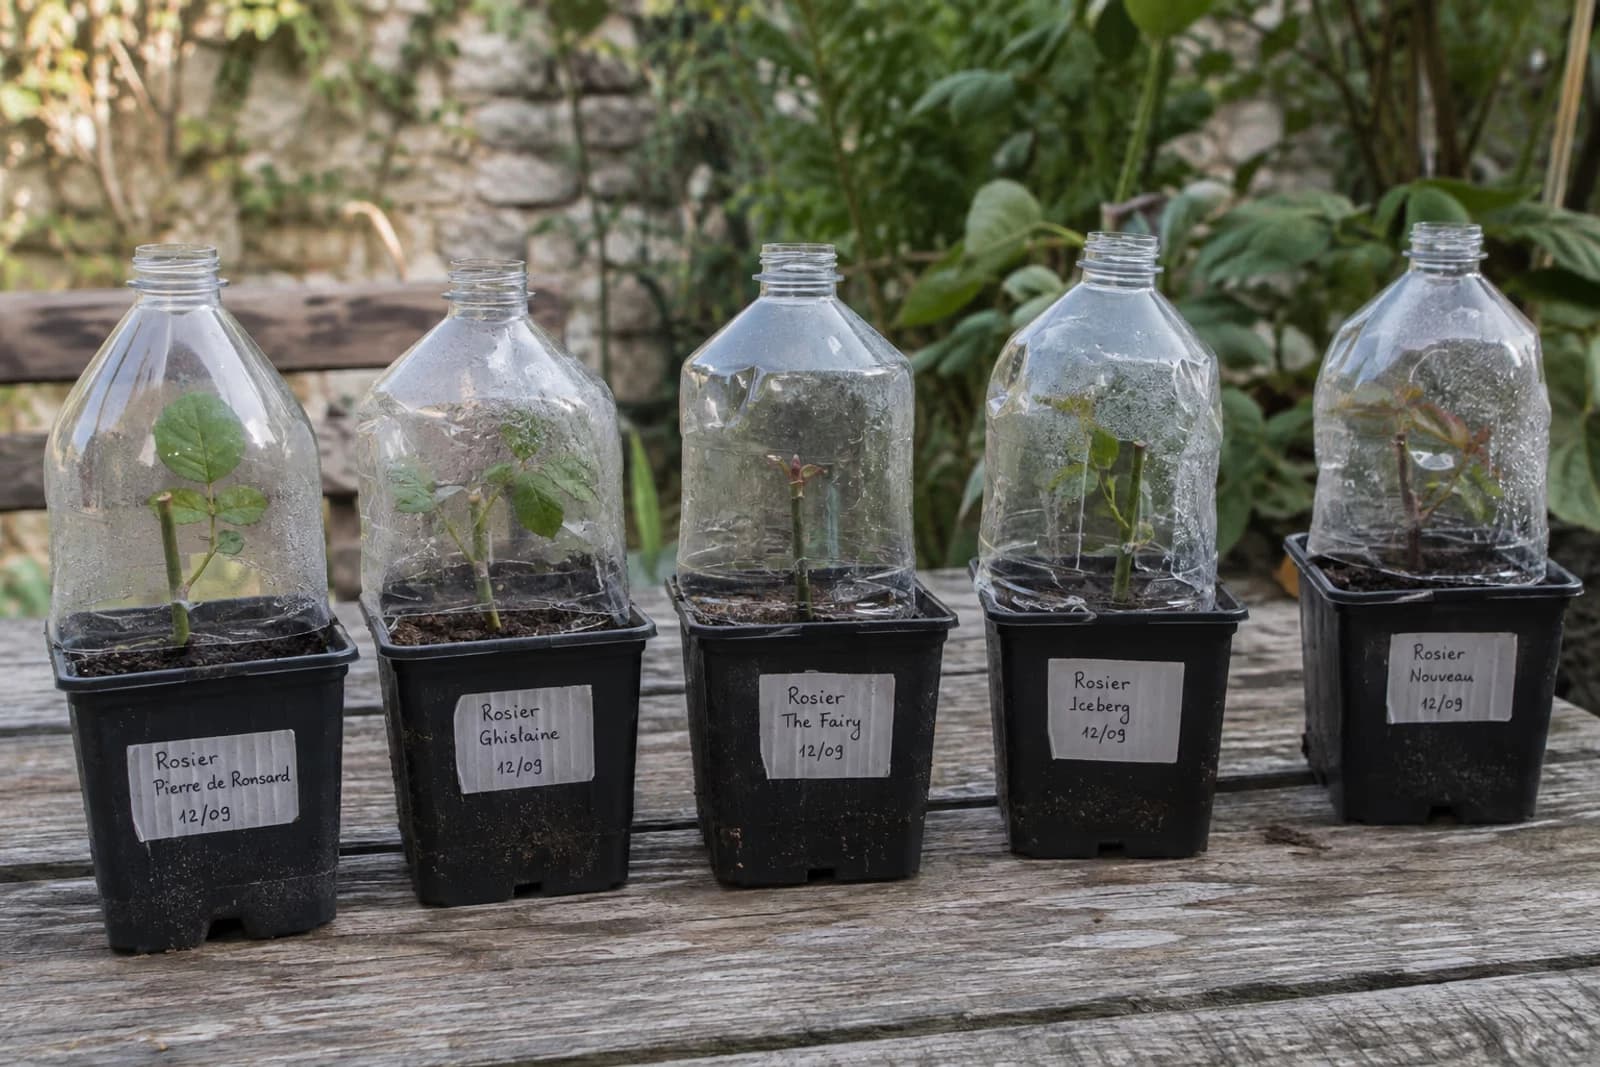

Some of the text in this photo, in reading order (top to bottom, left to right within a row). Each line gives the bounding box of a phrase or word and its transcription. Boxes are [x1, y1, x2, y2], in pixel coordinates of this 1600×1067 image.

[1413, 643, 1465, 660] Rosier
[1074, 671, 1131, 690] Rosier
[1409, 667, 1474, 683] Nouveau
[788, 686, 846, 705] Rosier
[1421, 694, 1463, 713] 12/09
[481, 703, 541, 722] Rosier
[479, 726, 560, 746] Ghislaine
[781, 712, 861, 741] The Fairy
[1081, 723, 1126, 744] 12/09
[155, 751, 219, 771] Rosier
[799, 741, 844, 761] 12/09
[497, 756, 542, 778] 12/09
[153, 766, 291, 796] Pierre de Ronsard
[178, 804, 231, 826] 12/09
